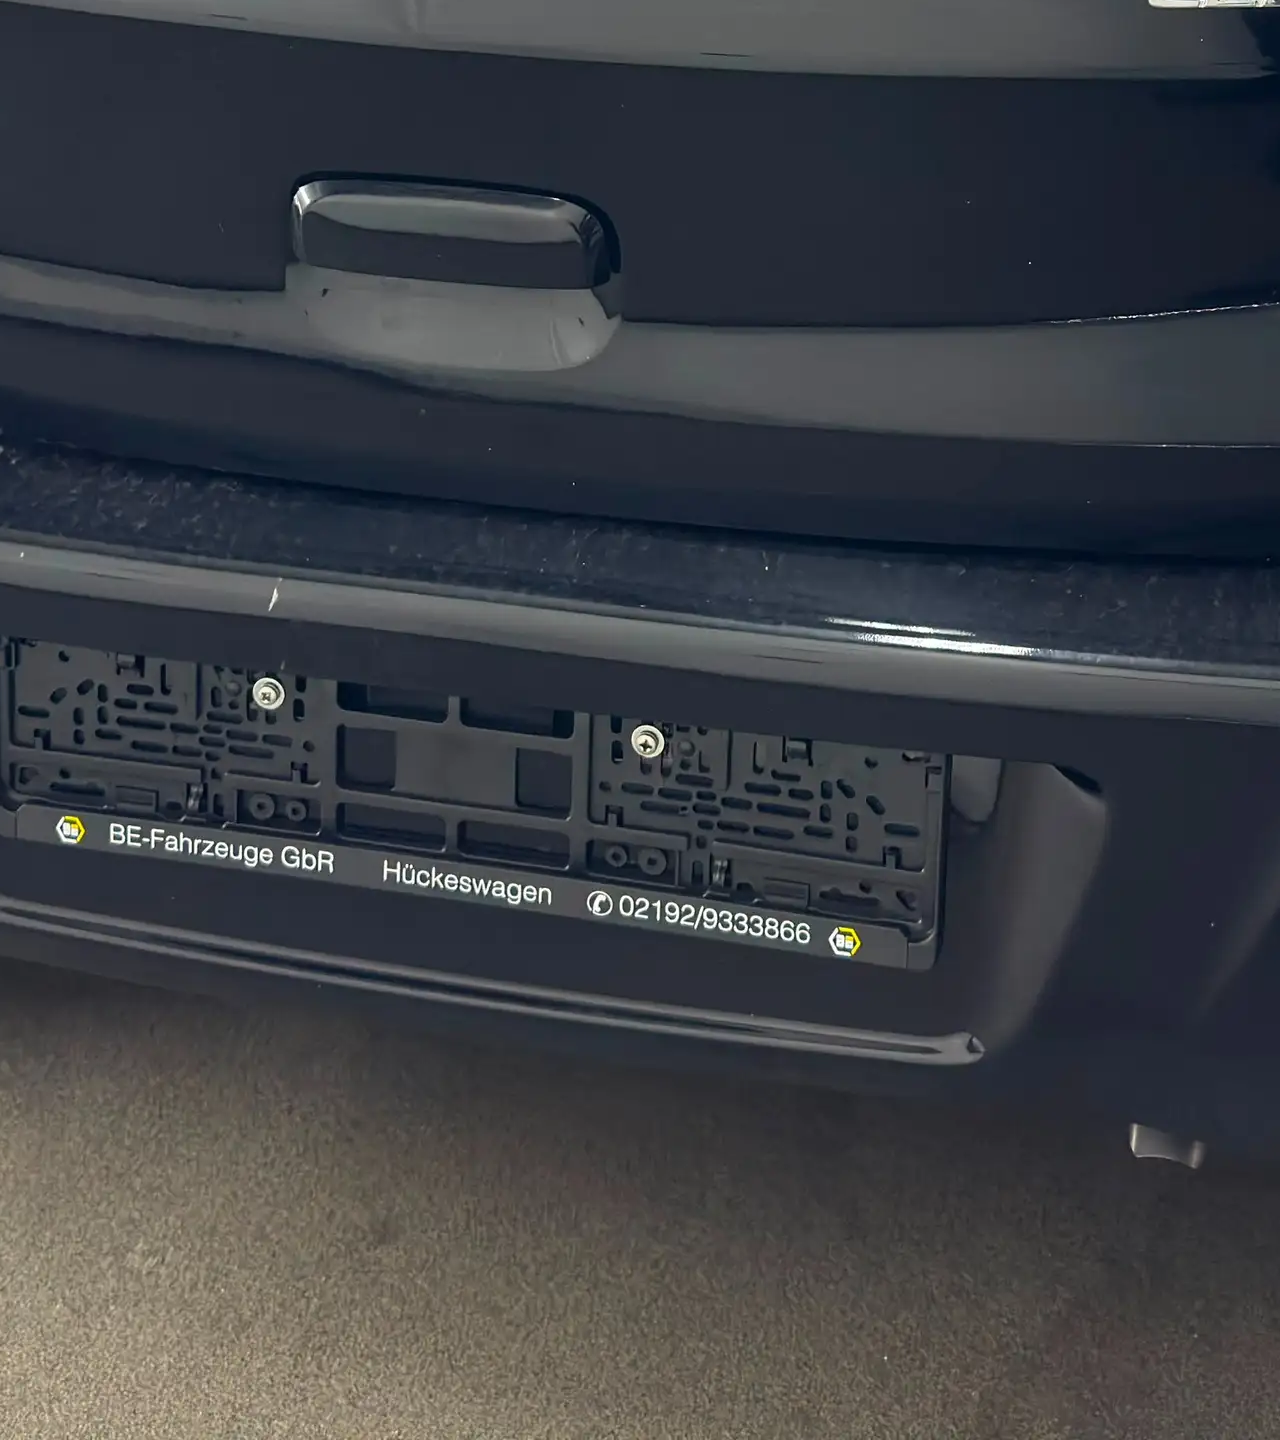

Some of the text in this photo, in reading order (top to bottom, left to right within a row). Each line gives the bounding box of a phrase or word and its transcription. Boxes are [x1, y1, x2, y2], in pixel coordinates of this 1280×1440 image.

[108, 822, 812, 945] BE-Fahrzeuge GbR Hückeswagen 02192/9333866
